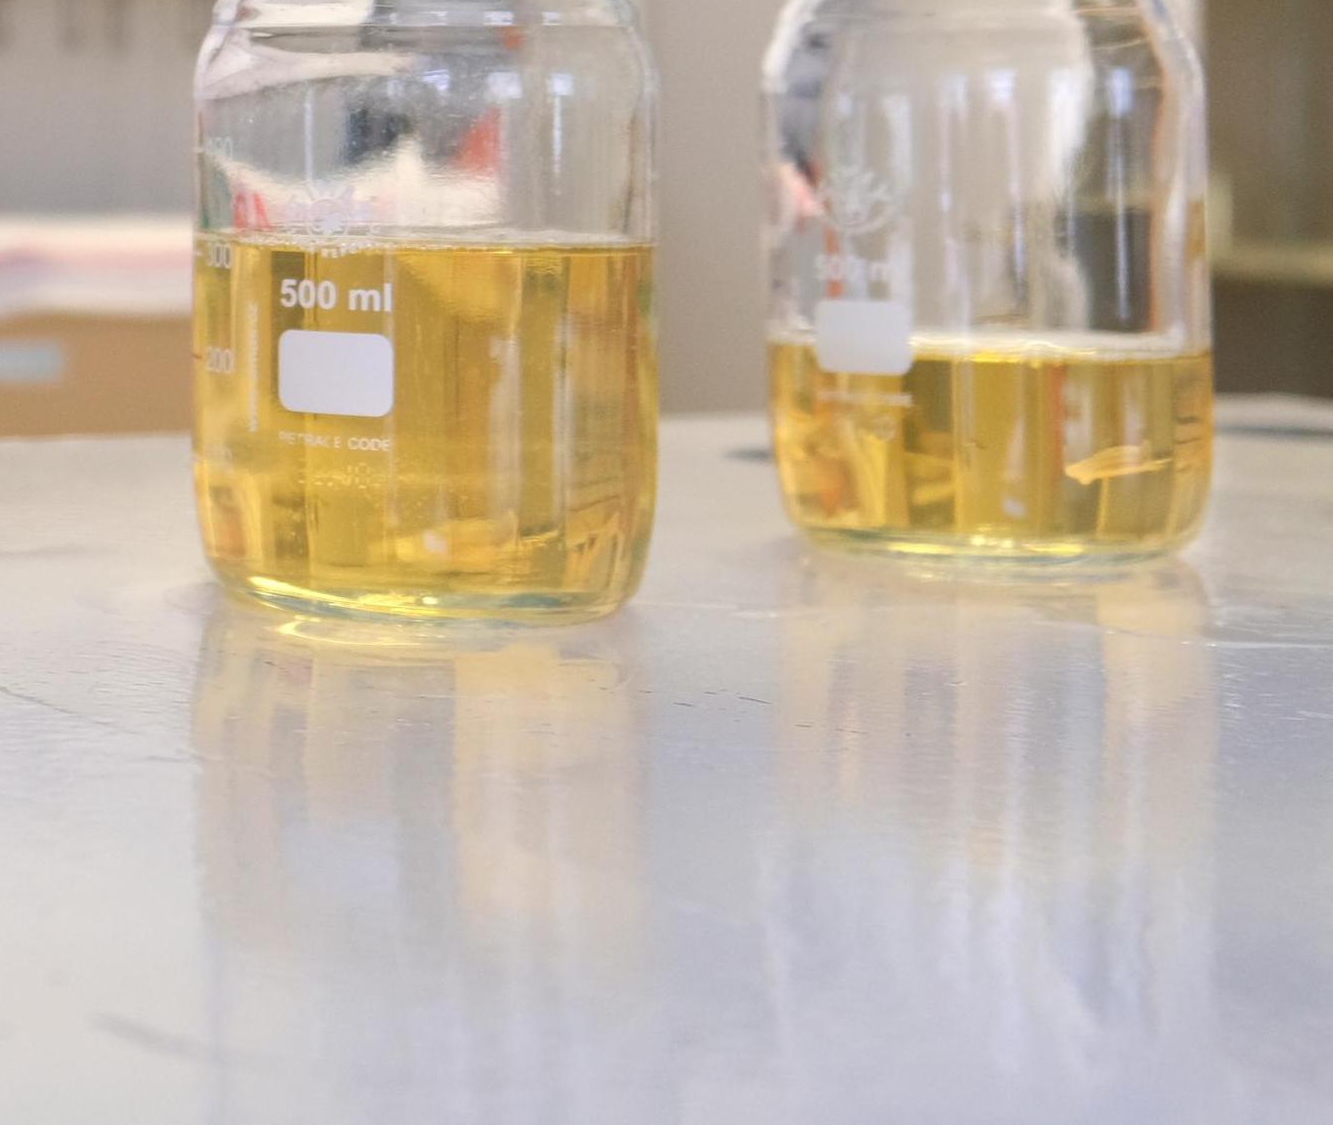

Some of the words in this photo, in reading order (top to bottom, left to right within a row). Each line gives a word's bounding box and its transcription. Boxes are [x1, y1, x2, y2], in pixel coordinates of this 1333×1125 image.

[280, 278, 338, 311] 500
[347, 282, 394, 313] ml
[346, 436, 391, 452] CODE
